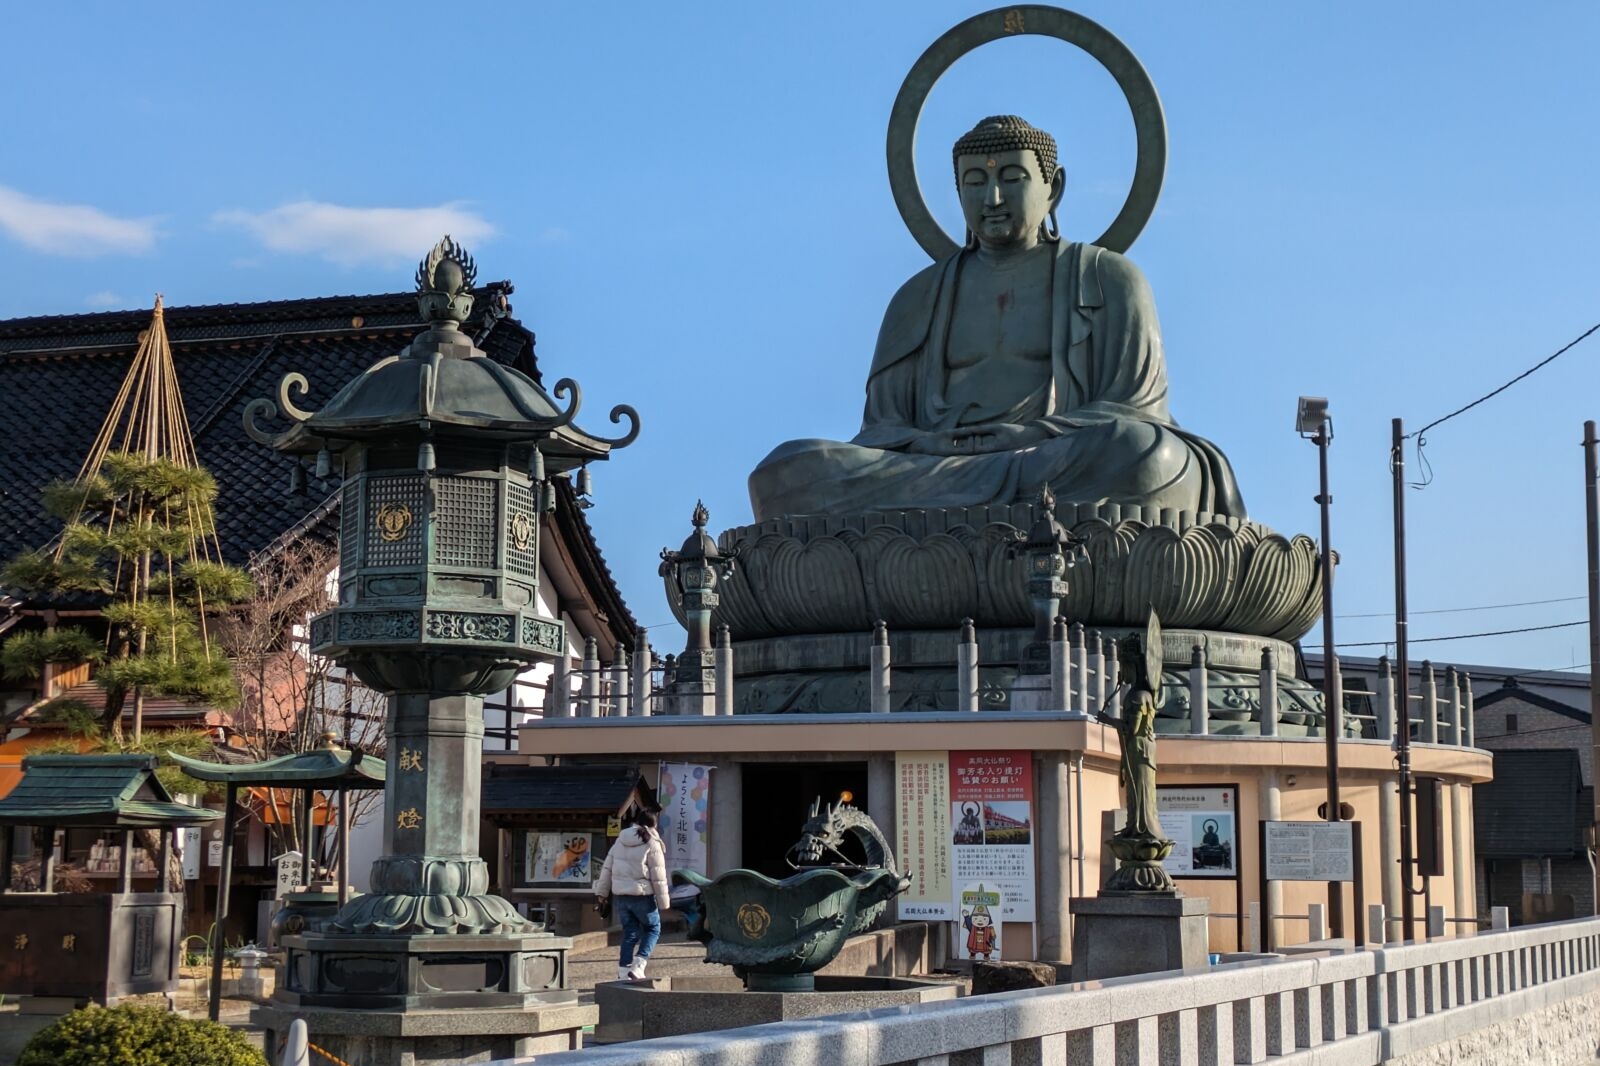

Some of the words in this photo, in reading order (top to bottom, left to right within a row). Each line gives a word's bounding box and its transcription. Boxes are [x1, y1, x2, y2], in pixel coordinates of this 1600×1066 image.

[957, 766, 1023, 776] 御芳名入り提灯
[962, 775, 1019, 784] 協賛のお願い
[677, 773, 688, 853] ようこそ北陸へ
[280, 860, 290, 883] お守
